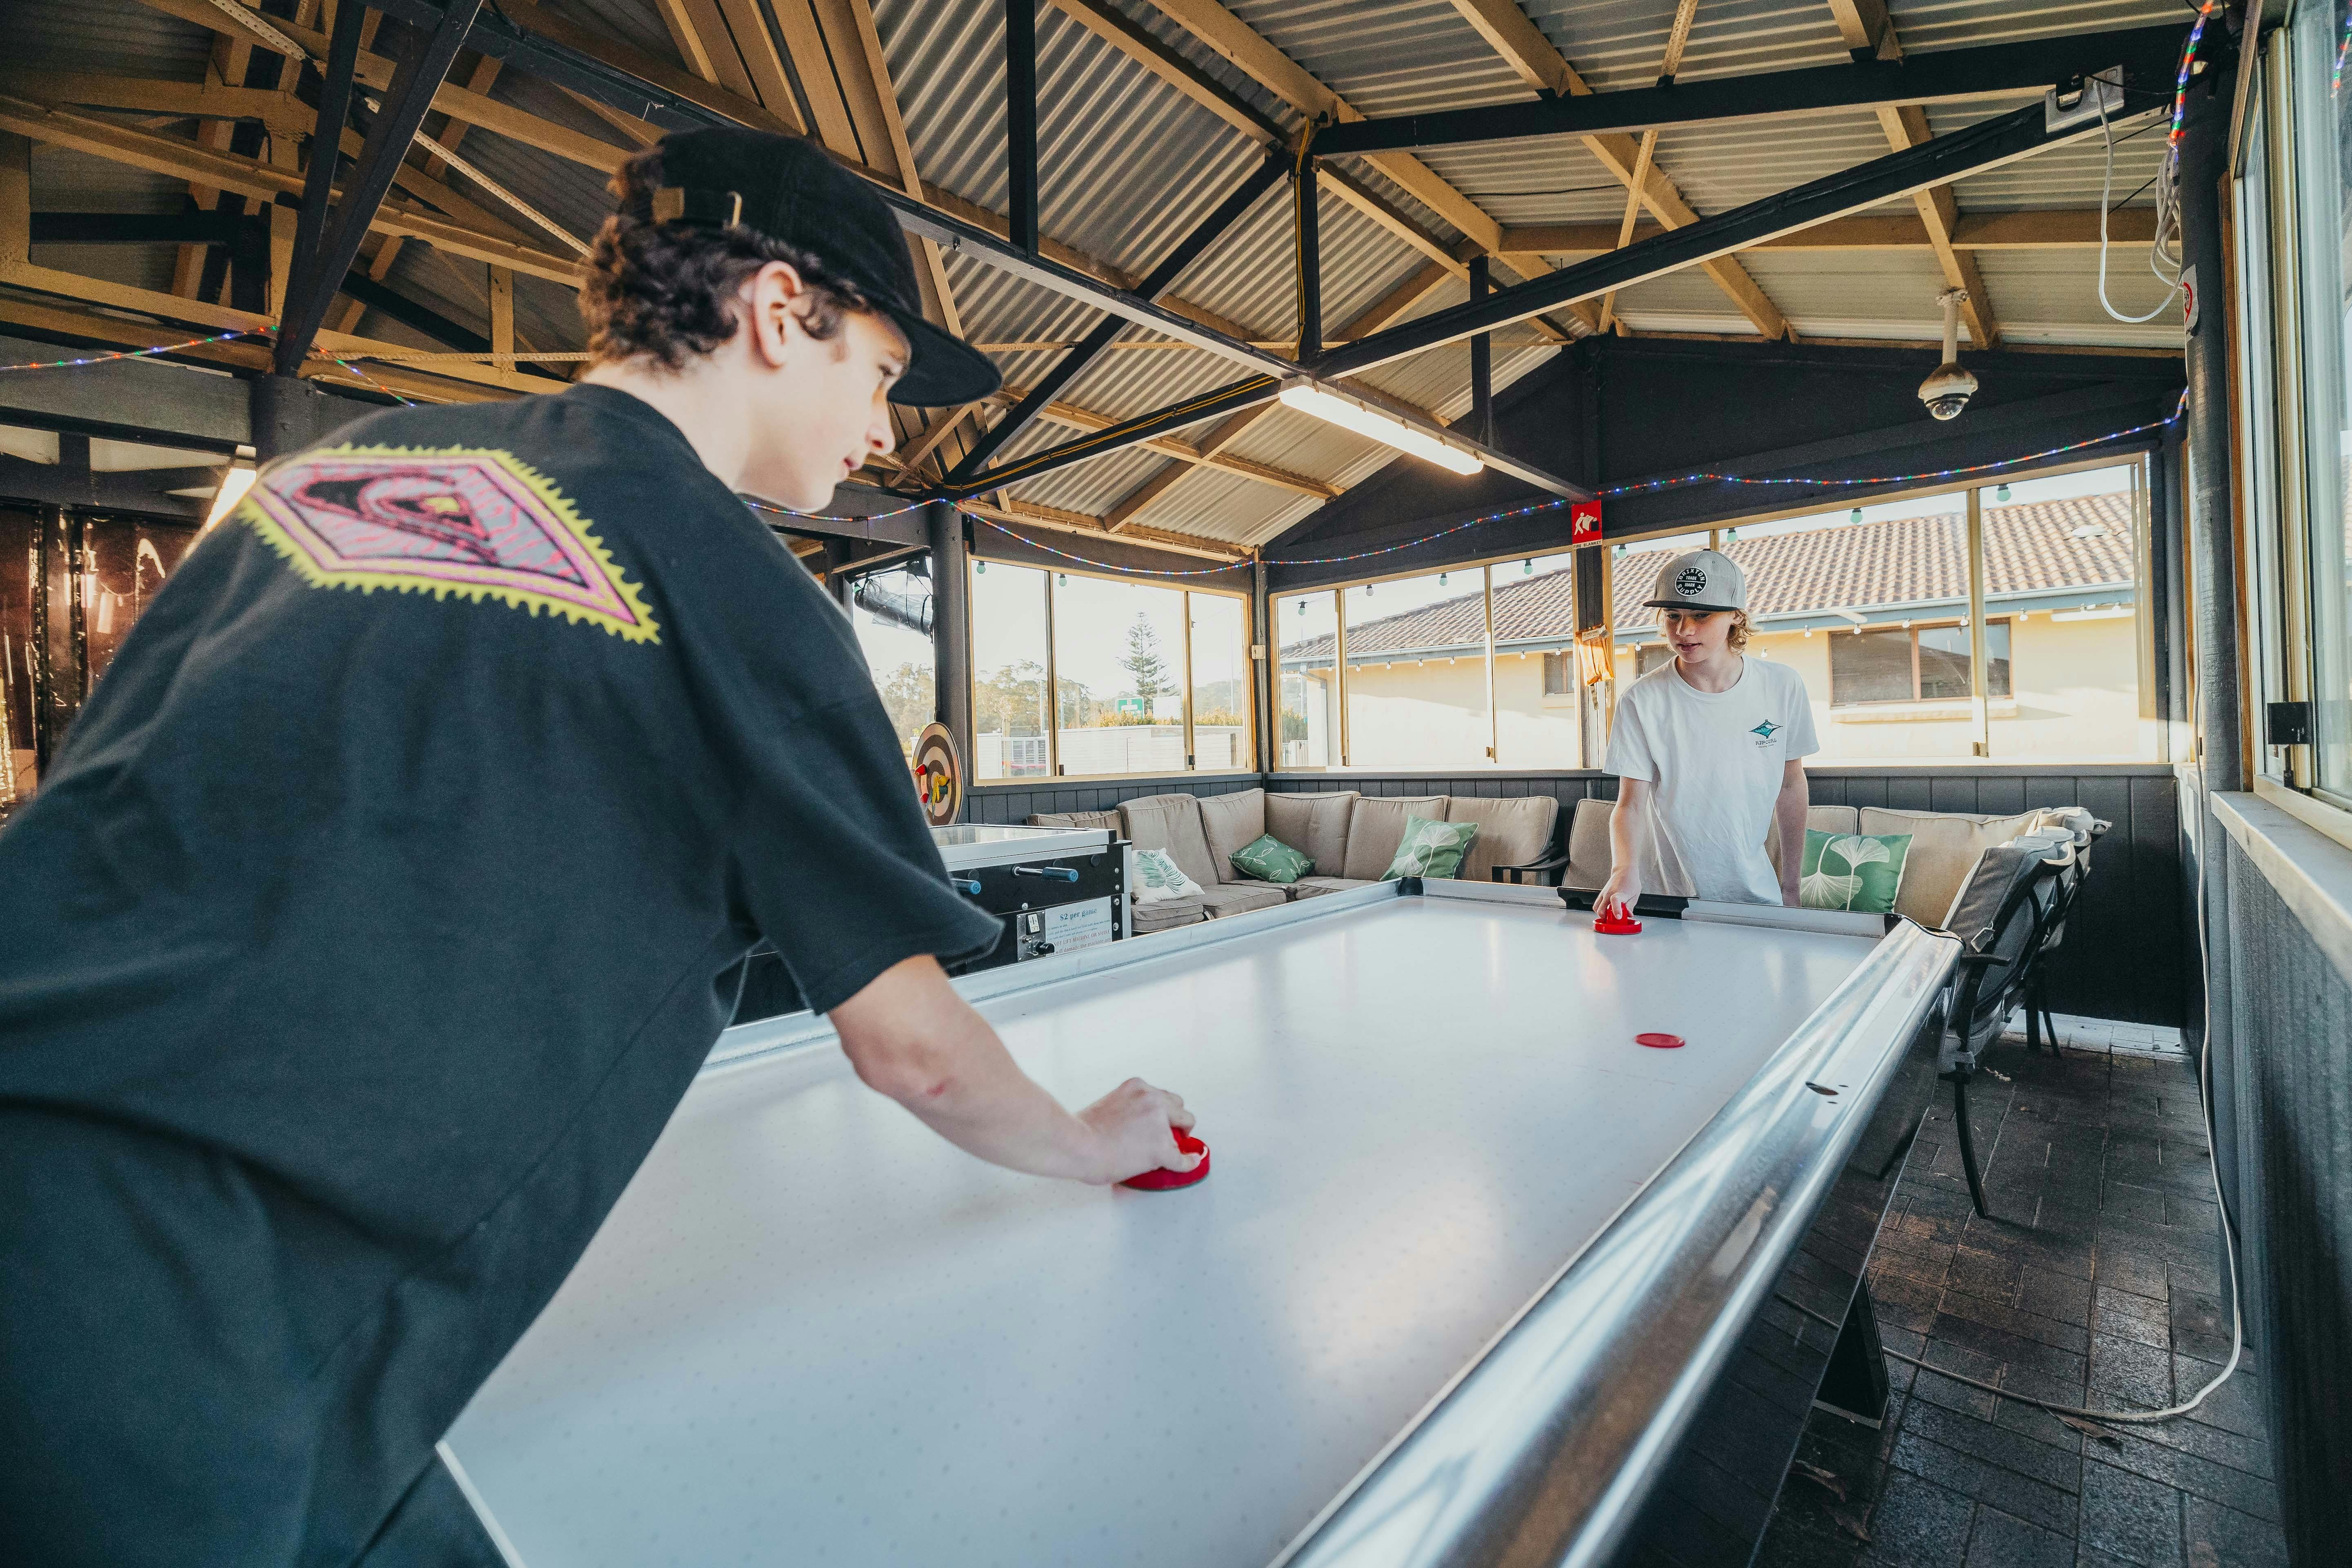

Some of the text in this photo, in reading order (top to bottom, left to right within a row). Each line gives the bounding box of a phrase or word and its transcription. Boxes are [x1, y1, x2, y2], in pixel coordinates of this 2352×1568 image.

[1678, 568, 1705, 581] BRIXTON
[1677, 584, 1703, 595] SUPPLY
[1070, 912, 1080, 920] per
[1082, 908, 1097, 918] game
[1072, 934, 1091, 942] MACHINE
